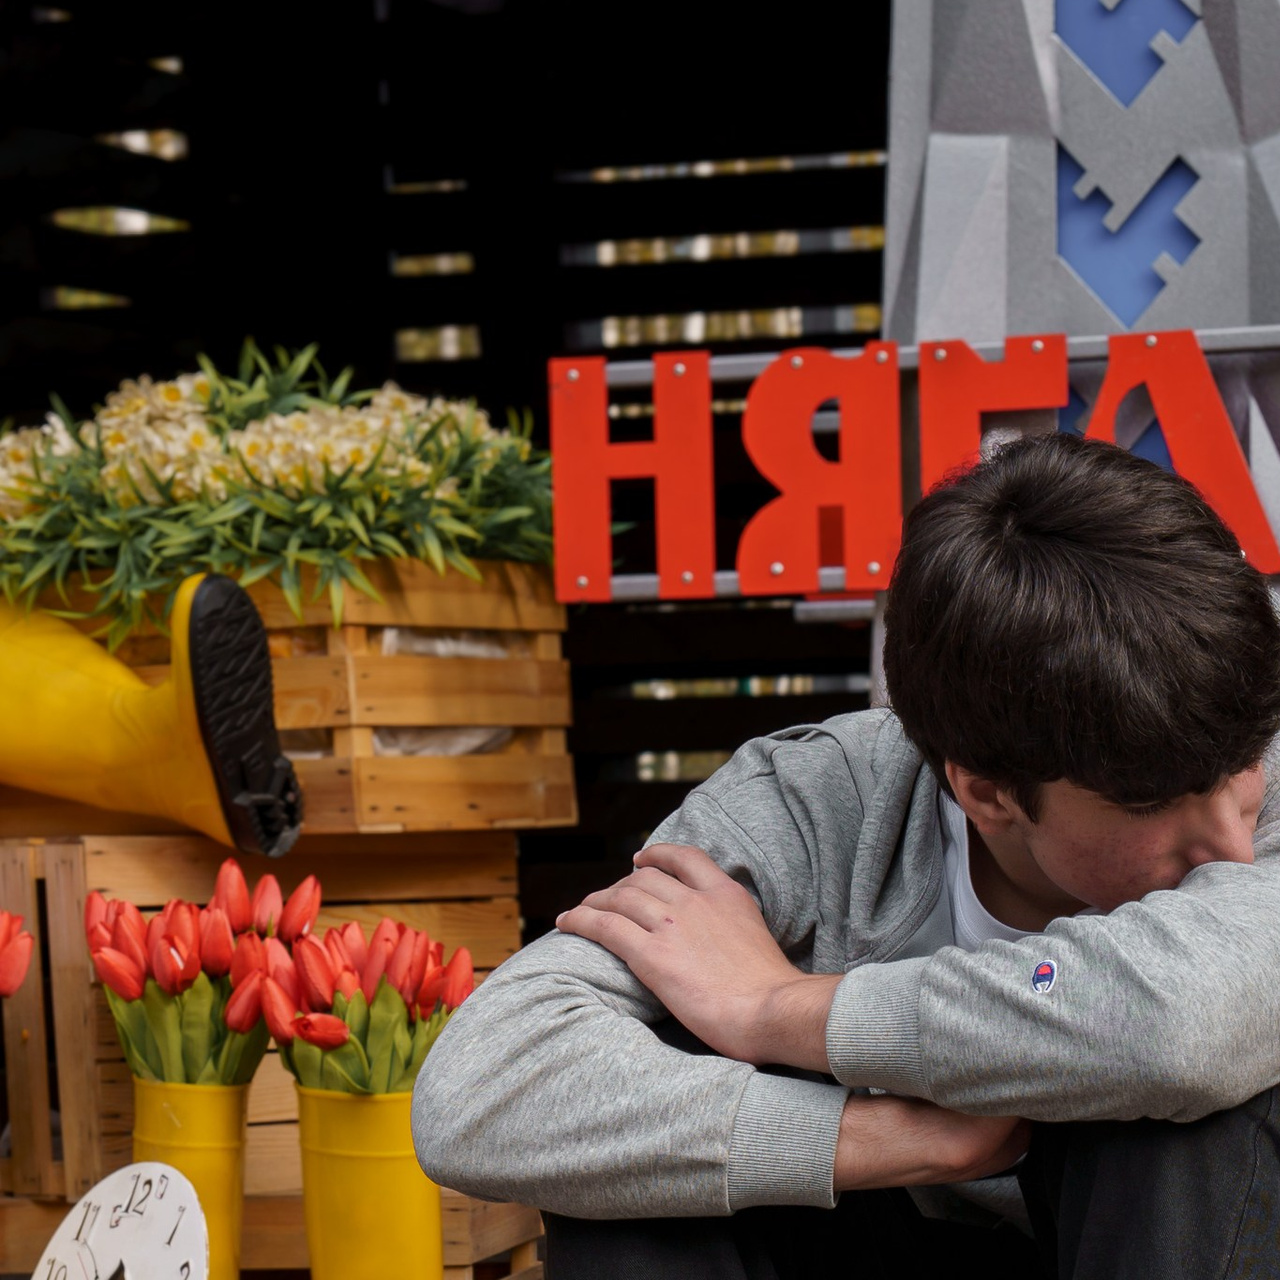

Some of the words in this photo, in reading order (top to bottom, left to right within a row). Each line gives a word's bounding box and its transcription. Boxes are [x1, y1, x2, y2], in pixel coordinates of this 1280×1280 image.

[123, 1173, 152, 1216] 12
[73, 1202, 101, 1247] 11
[165, 1205, 186, 1247] 1
